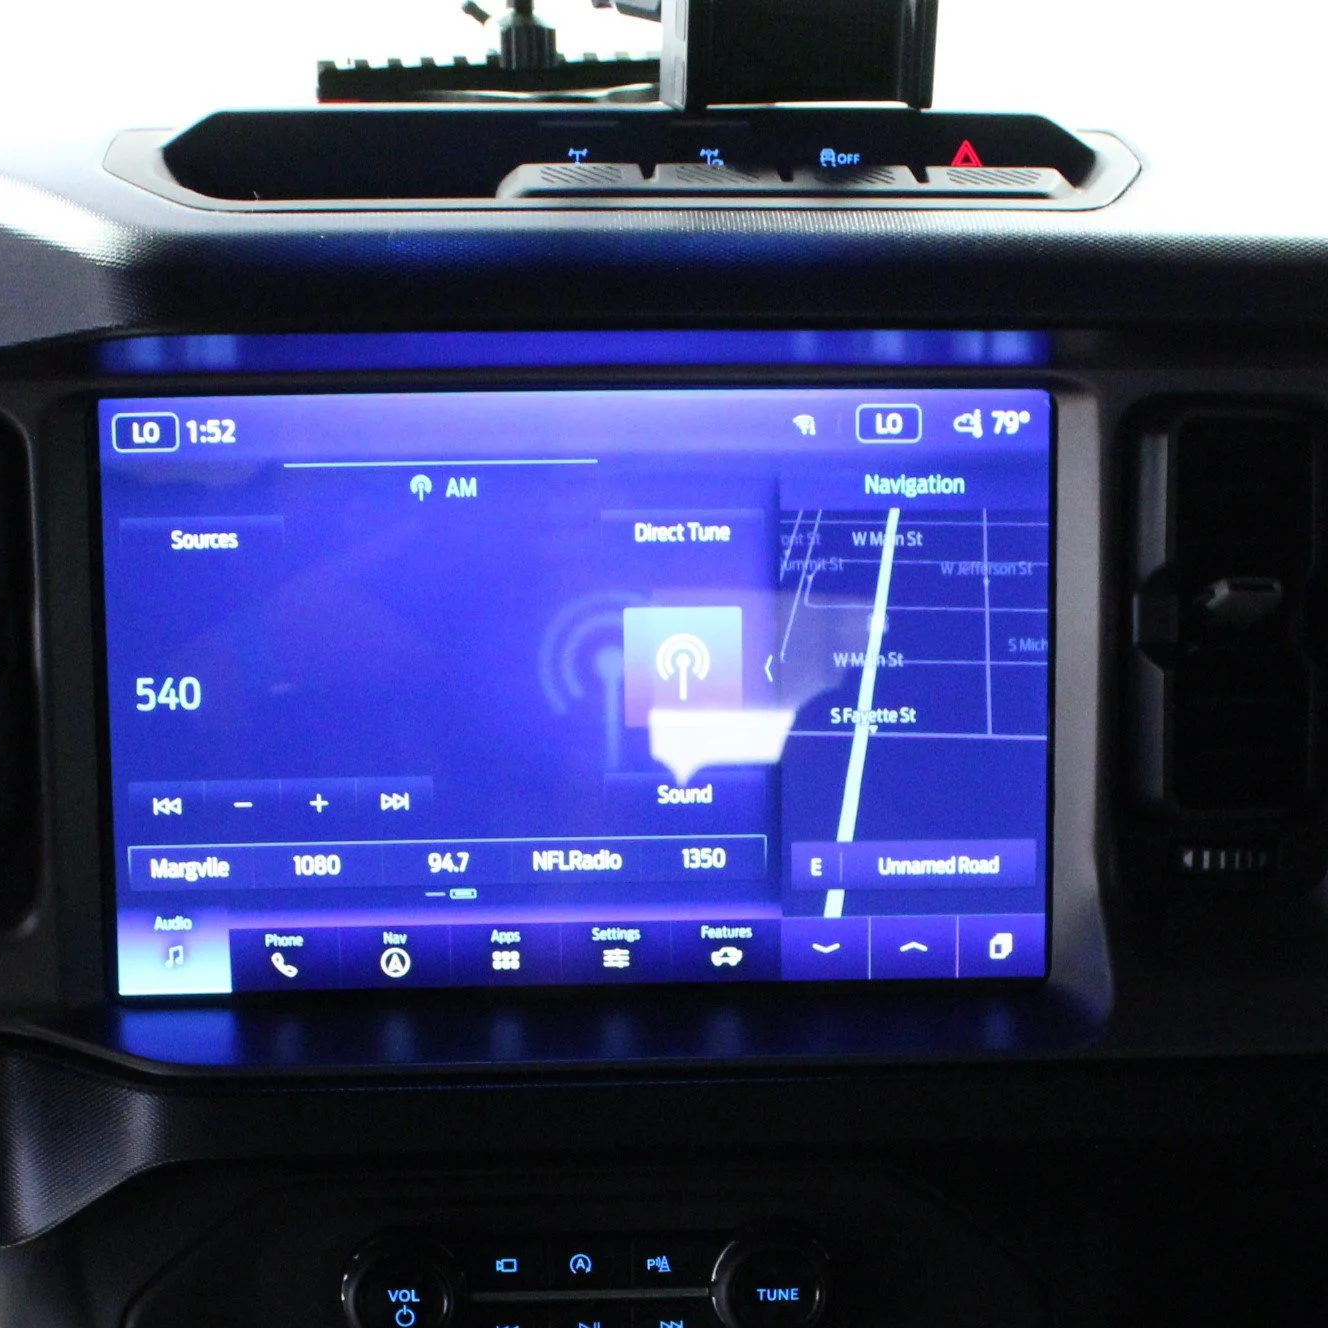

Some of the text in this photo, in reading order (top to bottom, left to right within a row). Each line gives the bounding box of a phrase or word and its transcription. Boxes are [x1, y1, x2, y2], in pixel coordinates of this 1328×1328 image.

[837, 153, 860, 165] OFF
[186, 418, 237, 444] 1:52
[875, 412, 903, 435] LO
[991, 410, 1031, 435] 79°
[132, 421, 160, 444] LO
[445, 477, 478, 498] AM
[864, 474, 965, 499] Navigation
[171, 530, 238, 550] Sources
[634, 521, 731, 543] Direct Tune
[852, 531, 867, 546] W
[907, 530, 923, 547] St
[829, 556, 844, 571] St
[940, 560, 1033, 576] W Jefferson St
[1008, 637, 1017, 652] S
[834, 652, 850, 668] W
[888, 651, 904, 668] St
[135, 676, 202, 712] 540
[830, 706, 917, 727] S Fayette St
[657, 784, 713, 804] Sound
[293, 854, 341, 876] 1080
[427, 852, 470, 873] 94.7
[681, 848, 726, 868] 1350
[811, 858, 822, 876] E
[877, 855, 1000, 875] Unnamed Road
[154, 916, 193, 931] Audio
[700, 926, 753, 940] Features
[264, 933, 304, 948] Phone
[383, 932, 407, 946] Nav
[490, 929, 521, 943] Apps
[591, 928, 641, 942] Settings
[388, 1290, 420, 1303] VOL
[757, 1288, 799, 1301] TUNE
